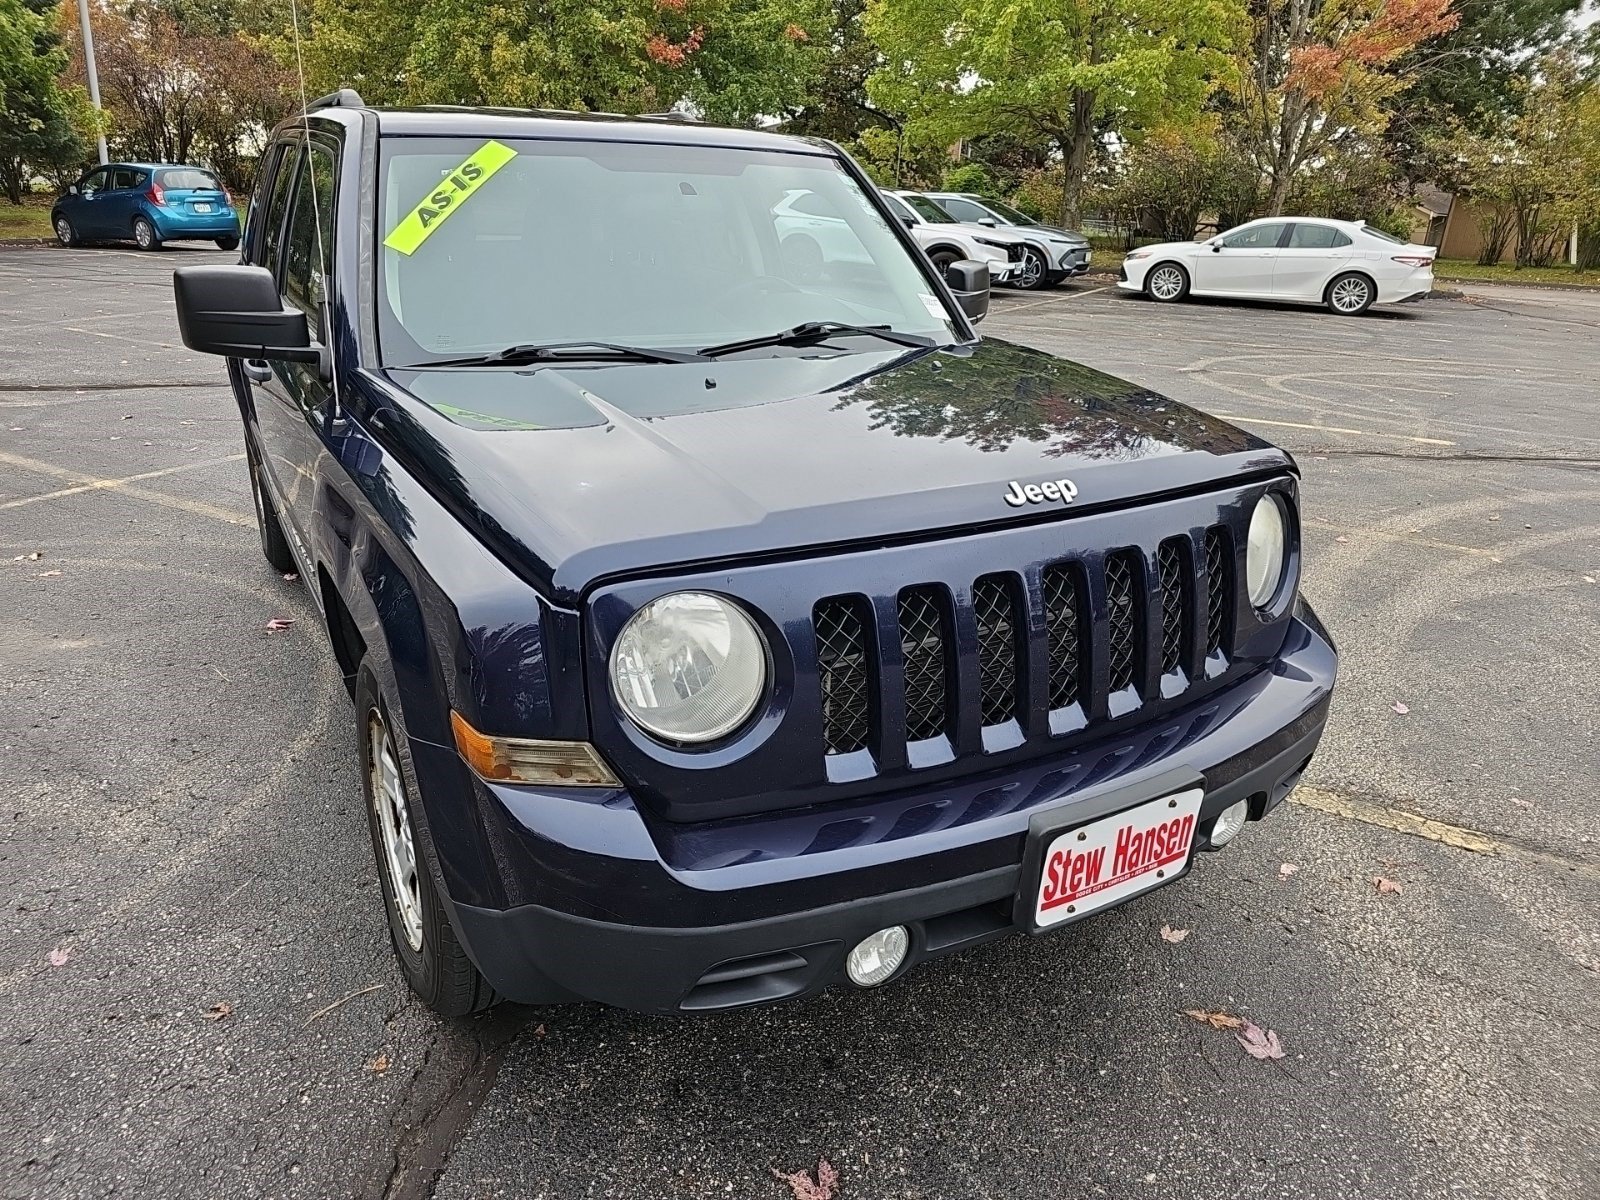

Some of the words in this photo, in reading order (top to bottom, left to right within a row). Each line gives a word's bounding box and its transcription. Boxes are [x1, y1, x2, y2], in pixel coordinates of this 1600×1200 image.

[417, 162, 483, 229] AS-IS
[1003, 478, 1078, 507] Jeep
[1043, 845, 1106, 901] Stew
[1112, 813, 1194, 877] Hansen
